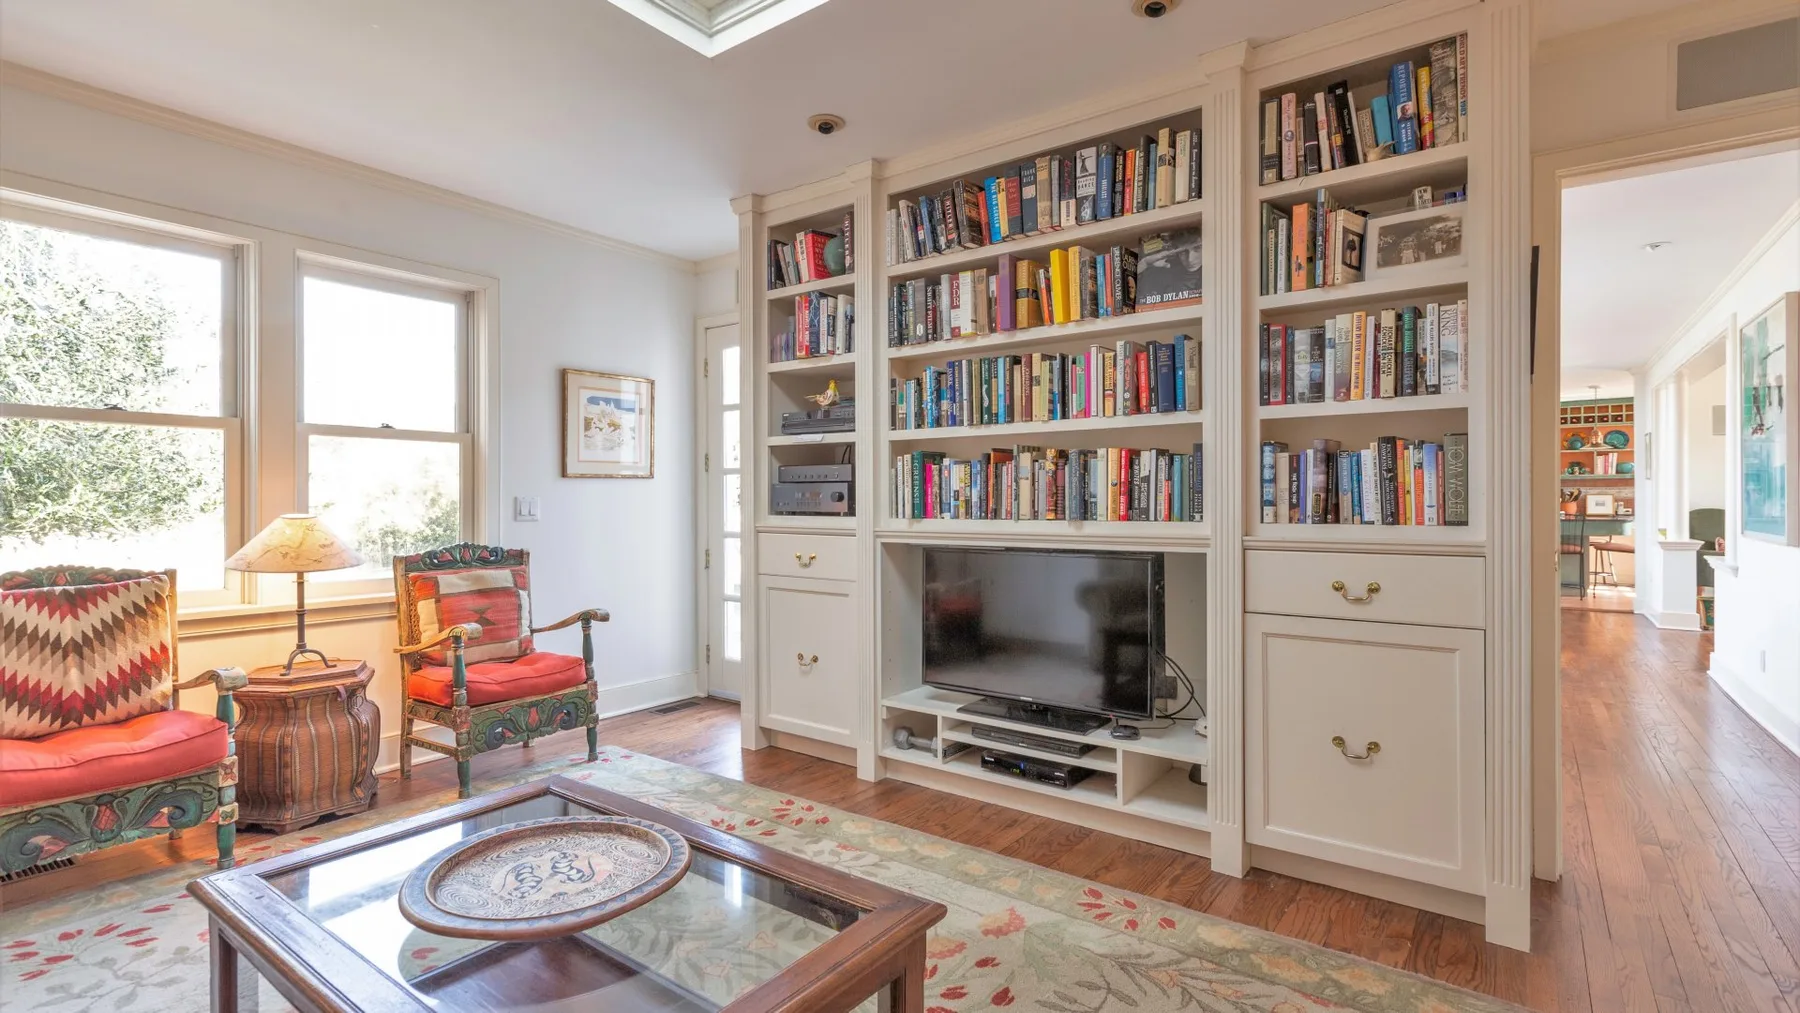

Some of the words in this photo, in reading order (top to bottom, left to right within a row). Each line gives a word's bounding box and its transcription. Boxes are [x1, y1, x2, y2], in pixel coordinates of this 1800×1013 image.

[1397, 64, 1406, 103] REPORTER
[1022, 168, 1036, 176] FRANK
[1078, 182, 1095, 190] DANCE
[952, 280, 960, 306] FDR
[1146, 294, 1161, 304] BOB
[1163, 290, 1189, 301] DYLAN
[1404, 313, 1413, 329] DAVID
[1441, 310, 1450, 336] KING
[1354, 334, 1362, 352] DEAVER
[1404, 331, 1413, 354] MORRELL
[1404, 357, 1413, 385] CREEPERS
[1448, 445, 1464, 473] TOM
[1448, 477, 1464, 514] WOLFE
